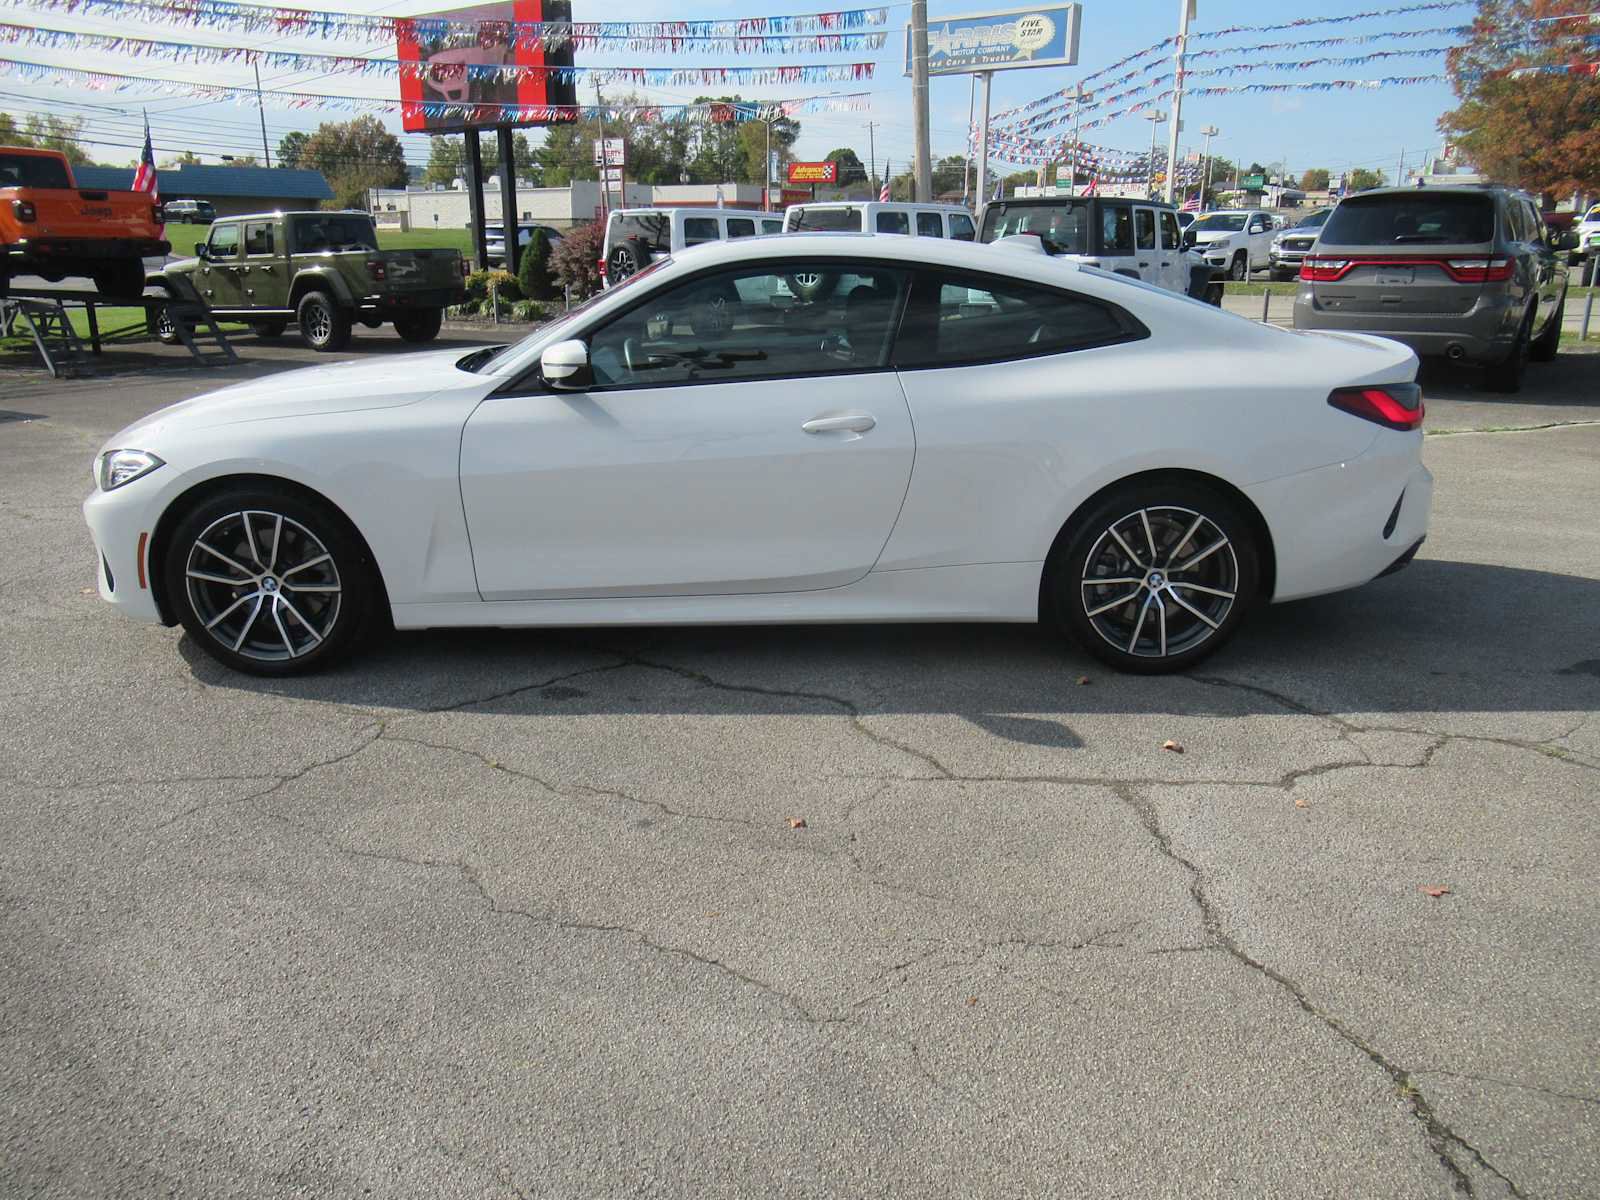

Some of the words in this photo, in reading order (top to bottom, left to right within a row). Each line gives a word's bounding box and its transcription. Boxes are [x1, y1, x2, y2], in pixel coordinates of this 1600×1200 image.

[1020, 19, 1042, 28] FIVE
[1020, 27, 1044, 37] STAR
[928, 23, 1017, 53] ARRIS
[951, 48, 975, 56] MOTOR
[977, 45, 1010, 54] COMPANY
[946, 58, 966, 66] Cars
[982, 55, 1011, 63] Trucks
